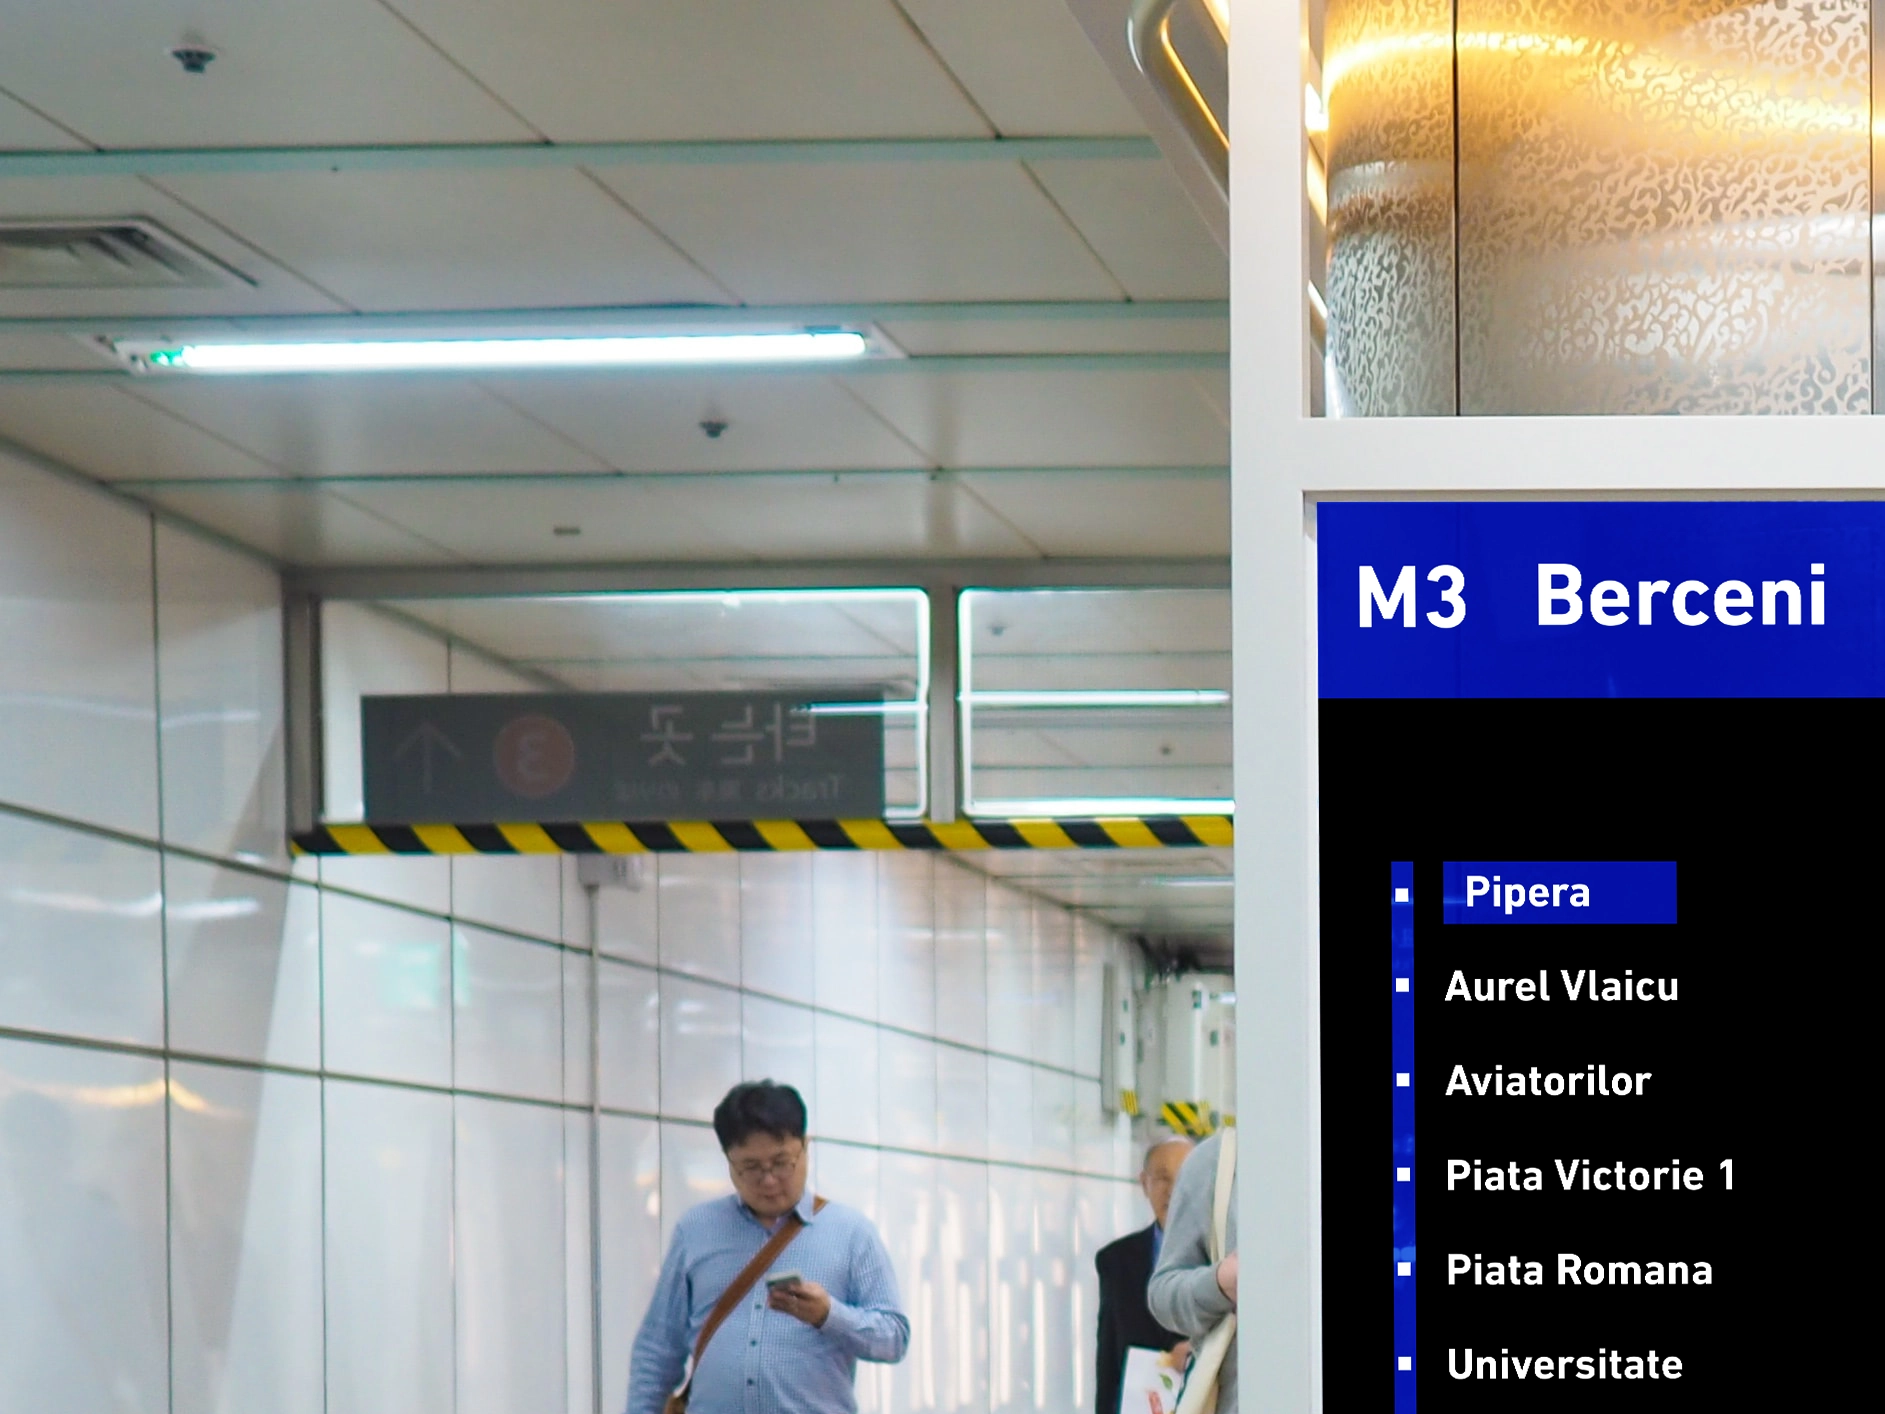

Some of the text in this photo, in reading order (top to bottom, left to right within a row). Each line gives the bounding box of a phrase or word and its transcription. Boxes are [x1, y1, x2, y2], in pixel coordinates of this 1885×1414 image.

[1358, 562, 1826, 630] M3 Berceni
[1466, 875, 1591, 915] Pipera
[1444, 969, 1679, 1003] Aurel Vlaicu
[1445, 1064, 1654, 1097] Aviatorilor
[1447, 1158, 1734, 1192] Piata Victorie 1
[1447, 1253, 1714, 1287] Piata Romana
[1448, 1348, 1684, 1381] Universitate
